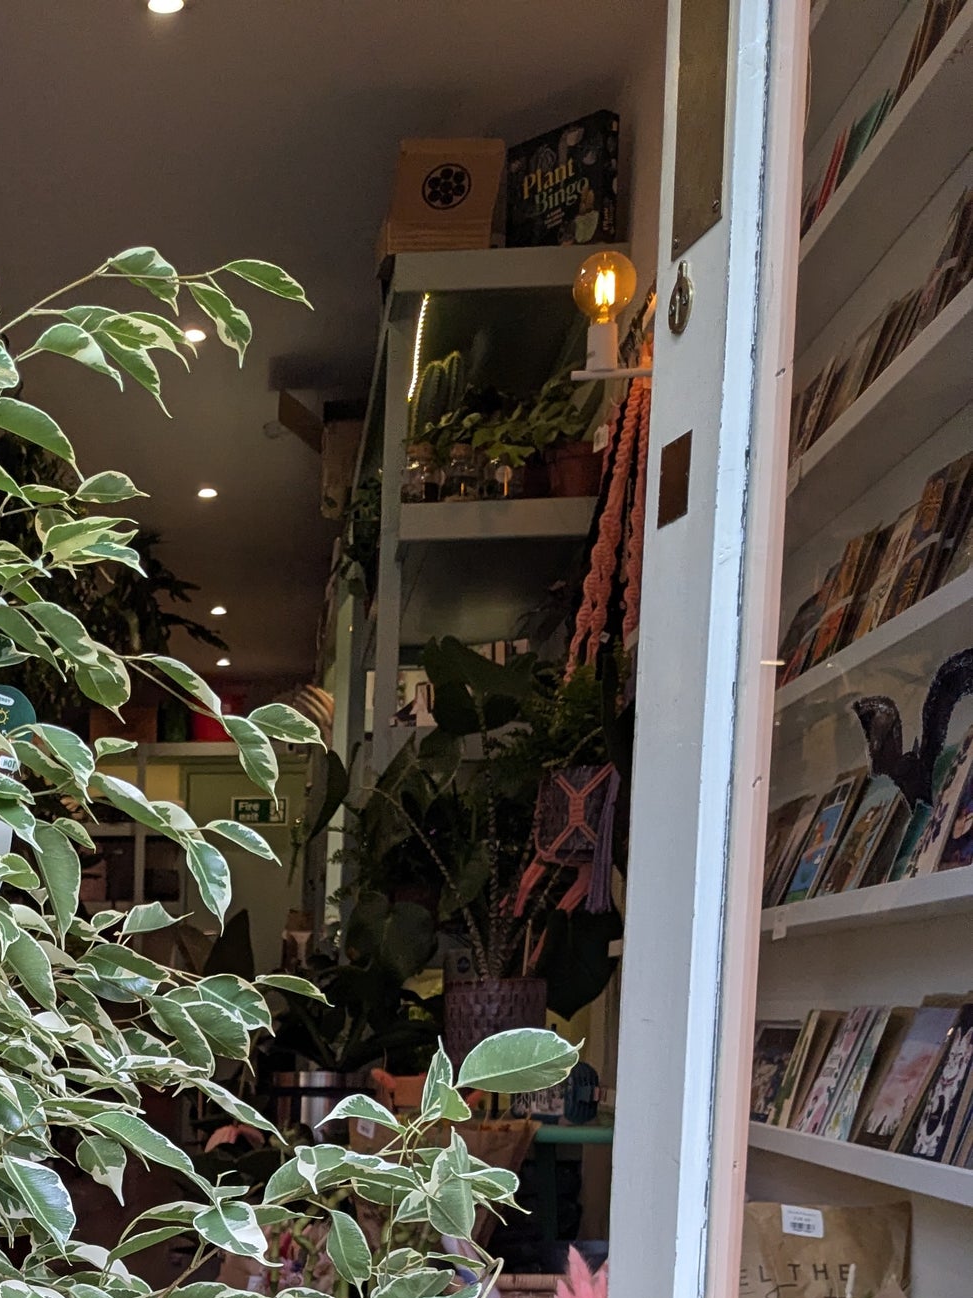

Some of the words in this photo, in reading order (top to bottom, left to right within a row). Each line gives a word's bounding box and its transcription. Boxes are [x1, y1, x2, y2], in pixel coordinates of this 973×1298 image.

[523, 158, 575, 200] Plant
[534, 177, 589, 213] Bingo
[238, 801, 260, 811] Fire
[787, 1264, 850, 1281] THE
